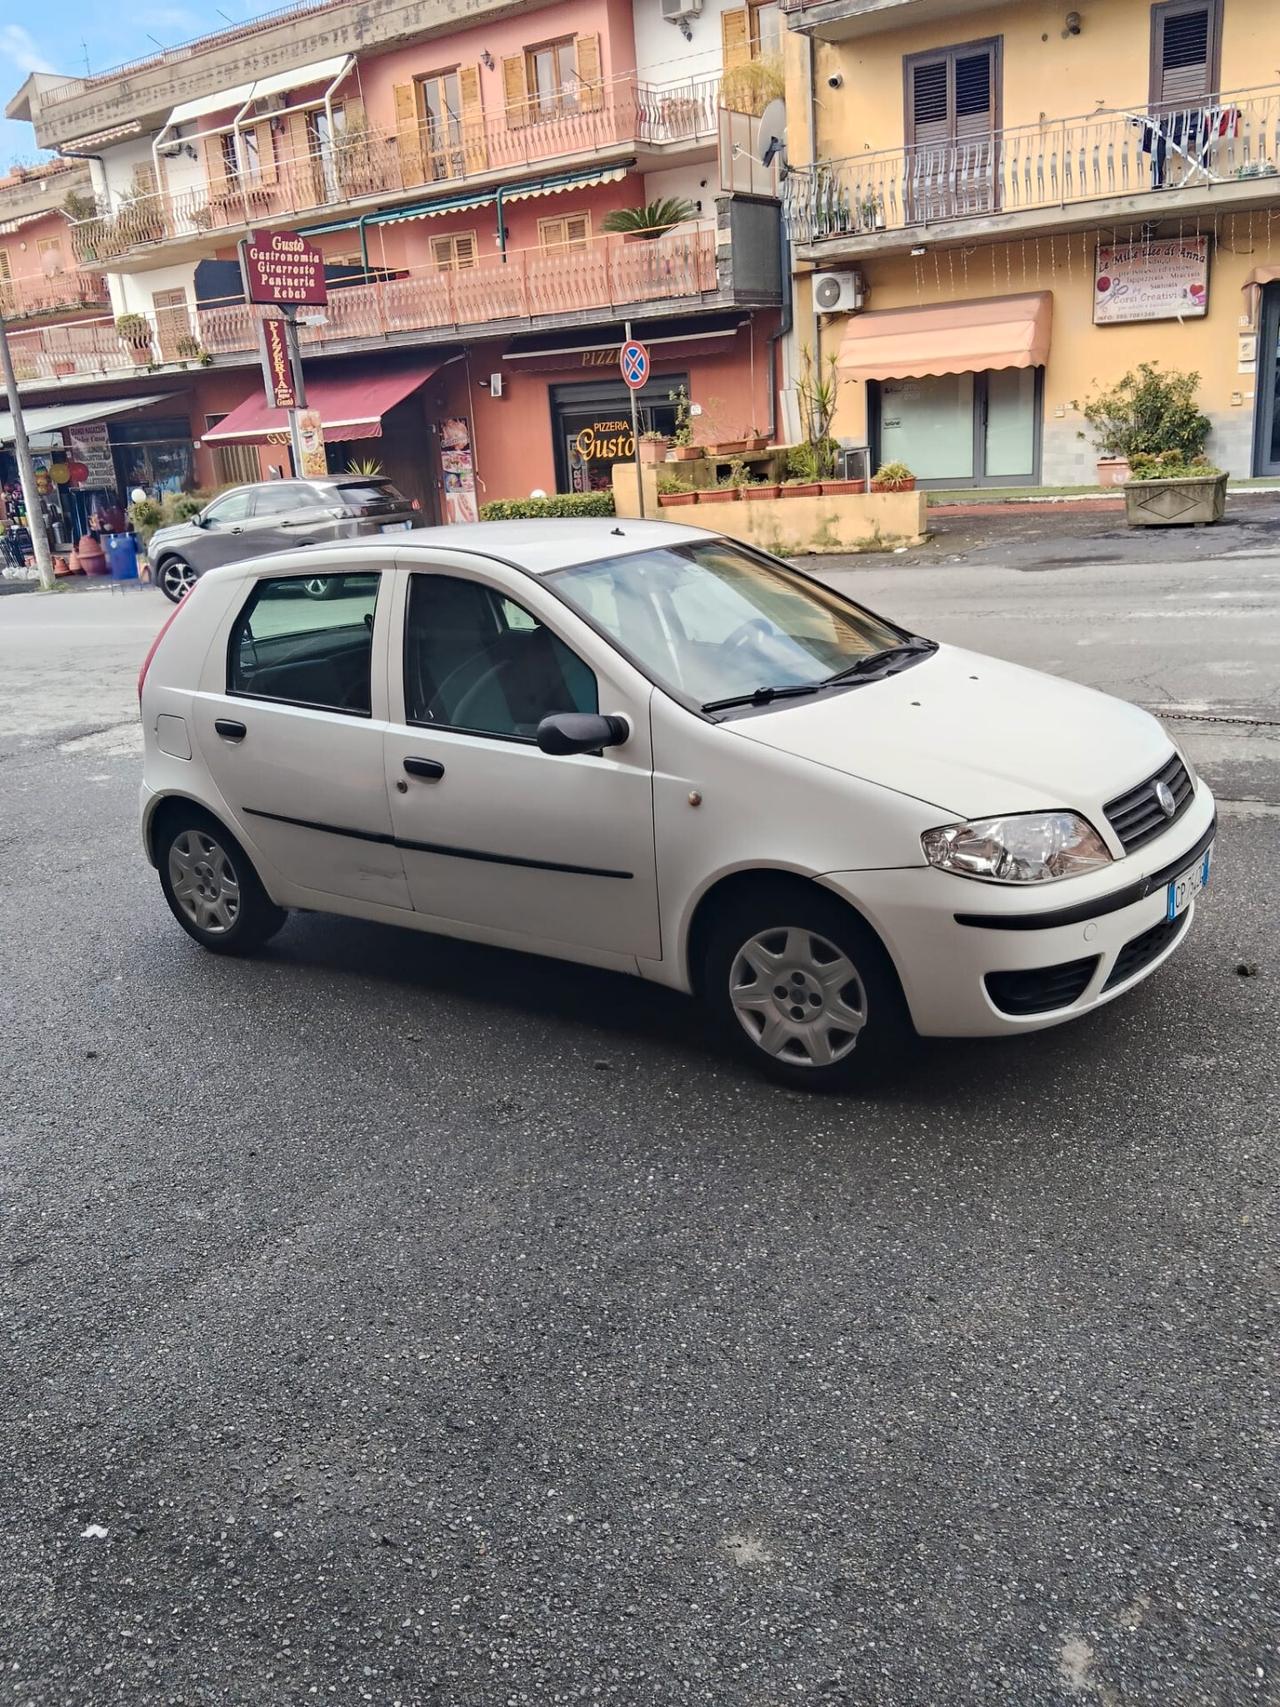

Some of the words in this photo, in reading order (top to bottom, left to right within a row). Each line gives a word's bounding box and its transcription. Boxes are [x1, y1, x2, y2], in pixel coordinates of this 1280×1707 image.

[272, 236, 305, 252] Gustò
[250, 248, 320, 263] Gastronomia
[1164, 243, 1176, 256] di
[1177, 246, 1206, 263] Anna
[257, 261, 315, 275] Girarrosto
[261, 274, 315, 287] Panineria
[273, 287, 307, 299] Kebab
[268, 321, 288, 389] PIZZERIA
[593, 420, 629, 432] PIZZERIA
[576, 428, 635, 461] Gustò
